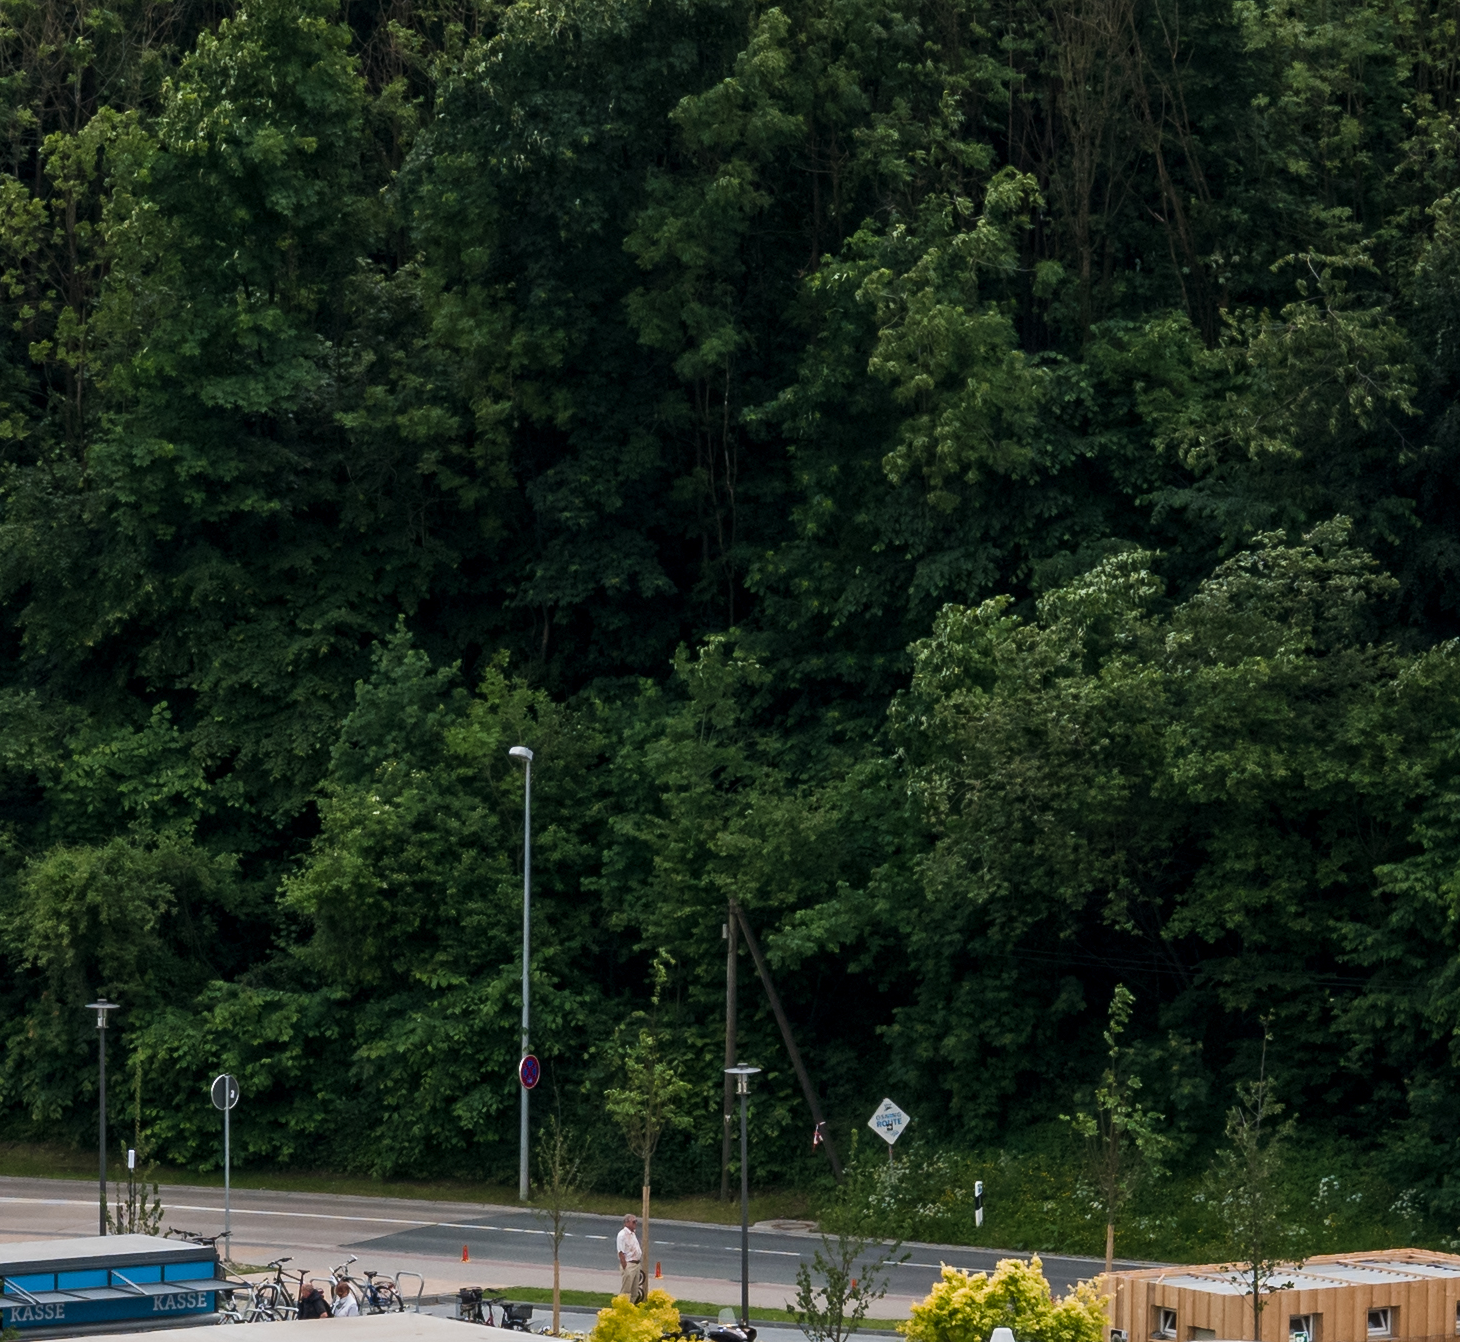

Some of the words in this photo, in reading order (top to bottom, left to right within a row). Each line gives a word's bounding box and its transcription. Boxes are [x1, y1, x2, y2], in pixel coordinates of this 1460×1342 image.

[876, 1112, 901, 1120] OSNING
[877, 1118, 902, 1127] ROUTE
[152, 1292, 207, 1311] KASSE
[10, 1303, 65, 1322] KASSE
